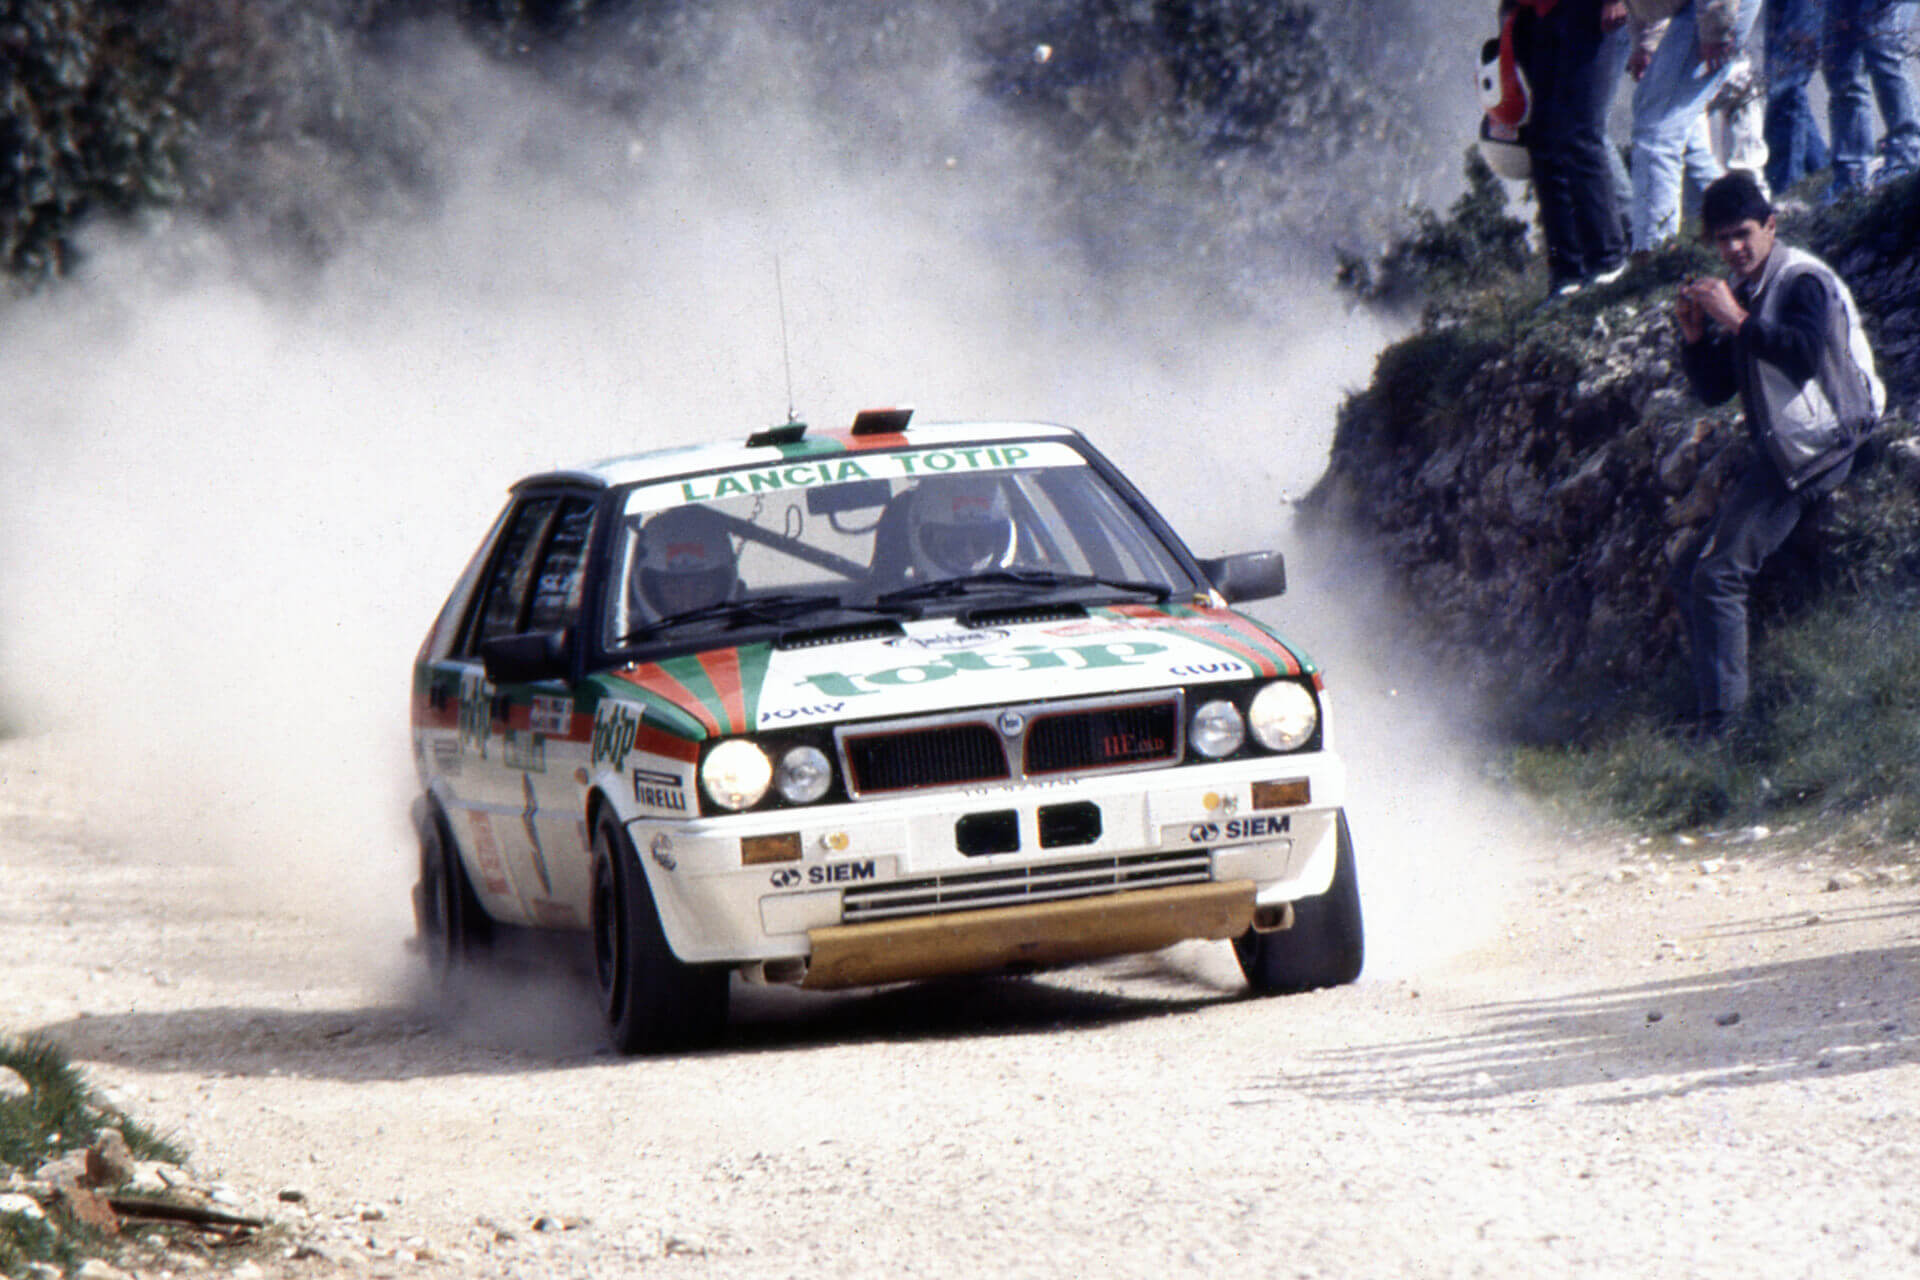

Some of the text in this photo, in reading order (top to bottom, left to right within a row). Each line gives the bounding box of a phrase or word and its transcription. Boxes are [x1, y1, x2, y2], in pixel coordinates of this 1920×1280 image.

[681, 447, 1029, 502] LANCIA TOTIP
[794, 641, 1169, 698] totip
[761, 702, 845, 723] JOLLY
[591, 703, 637, 774] totip
[633, 768, 687, 811] PIRELLI
[1225, 814, 1290, 839] SIEM
[808, 860, 875, 885] SIEM
